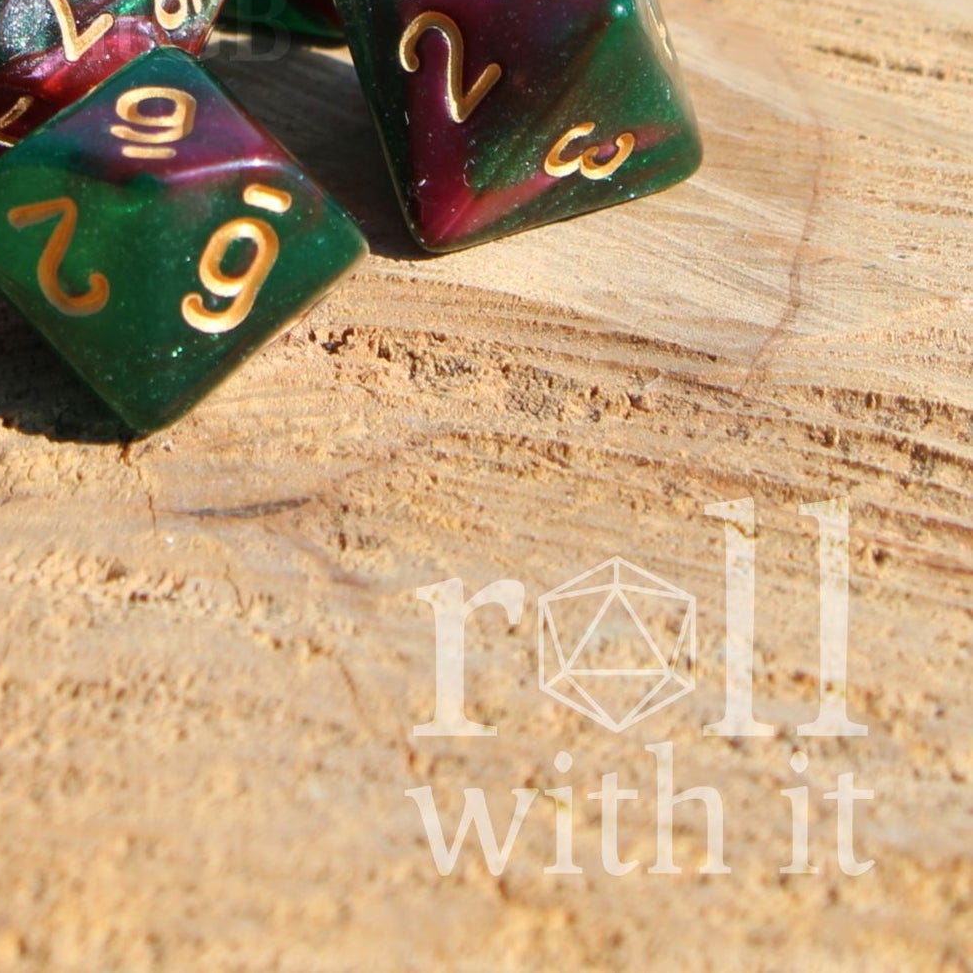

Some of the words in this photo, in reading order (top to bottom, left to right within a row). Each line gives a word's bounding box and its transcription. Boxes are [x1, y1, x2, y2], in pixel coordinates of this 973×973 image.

[399, 11, 501, 123] 2
[110, 86, 197, 160] 9
[544, 122, 635, 180] 3
[7, 196, 109, 316] 2
